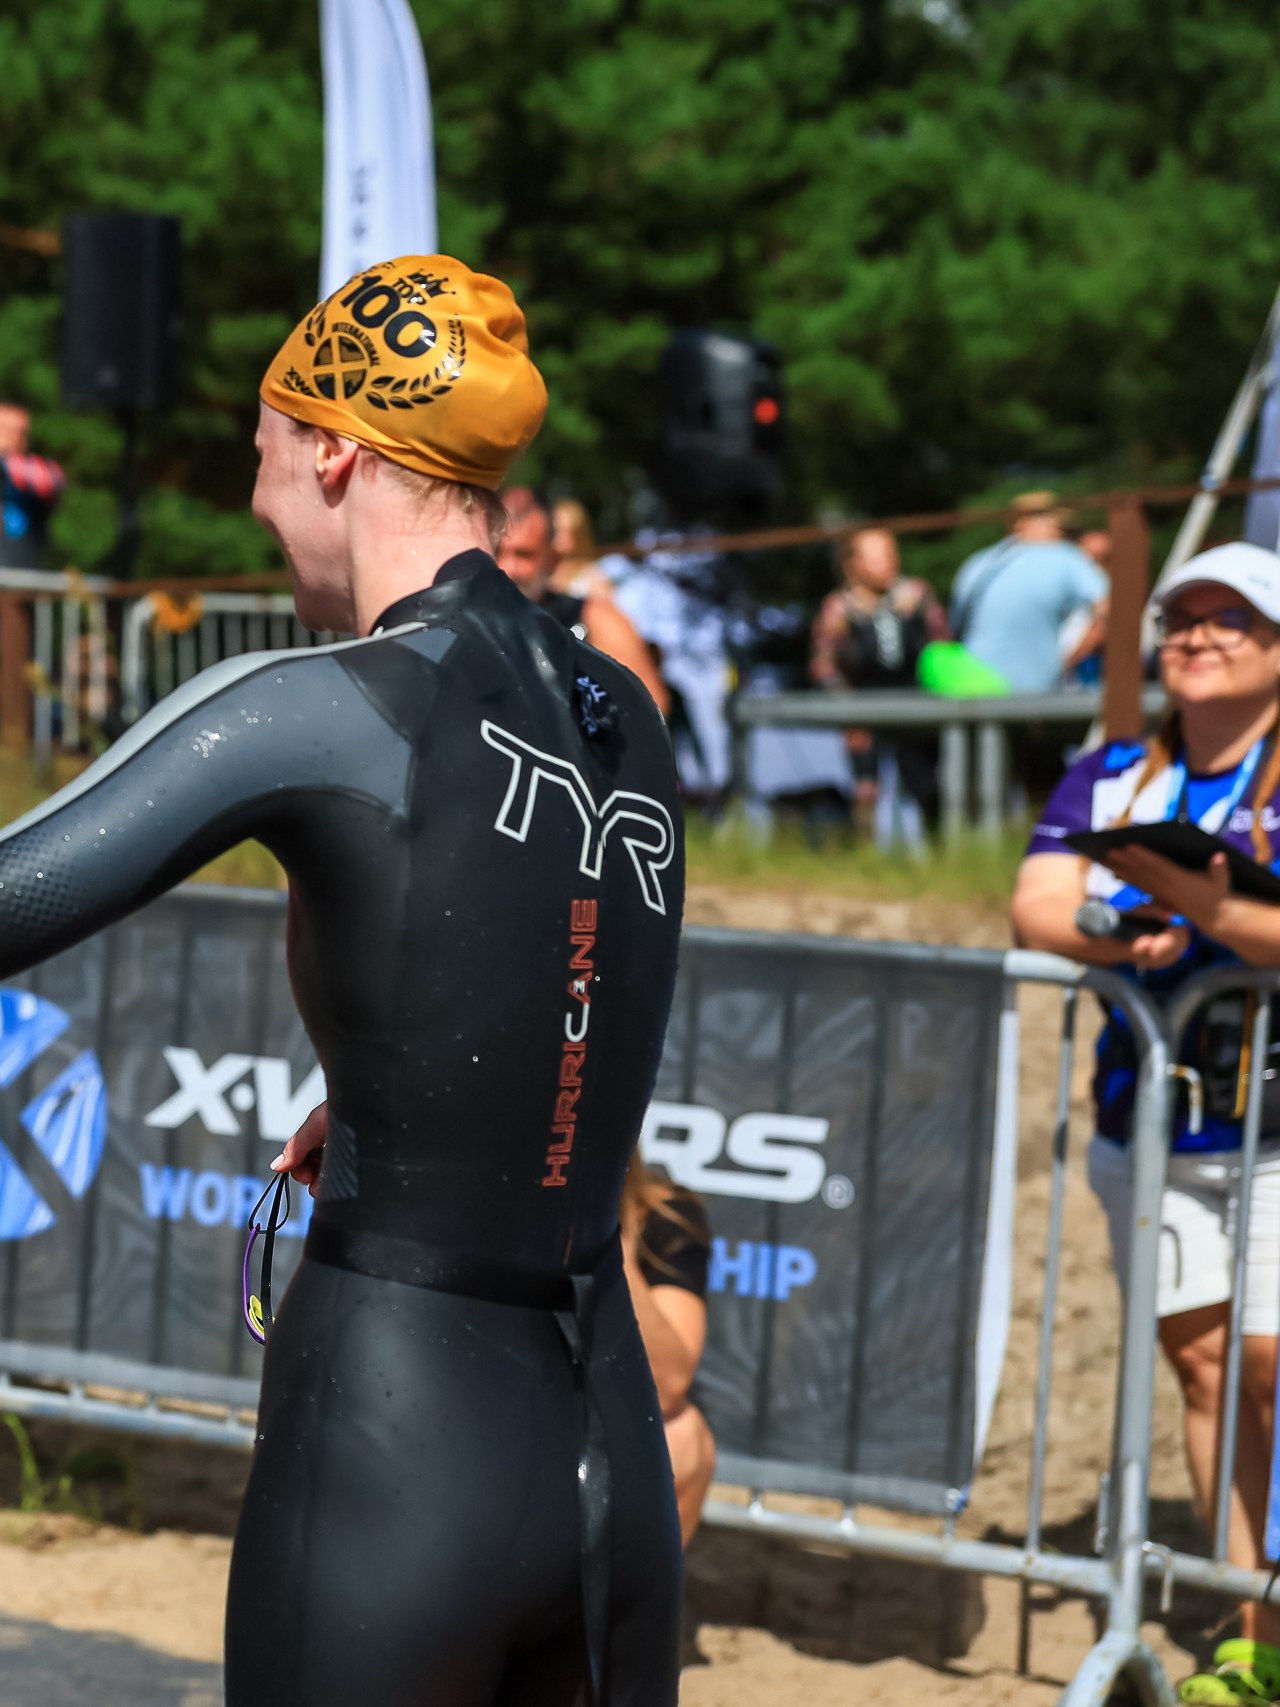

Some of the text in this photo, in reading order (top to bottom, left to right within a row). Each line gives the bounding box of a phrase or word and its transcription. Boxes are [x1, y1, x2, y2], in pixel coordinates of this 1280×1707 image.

[341, 275, 437, 358] 100
[481, 719, 675, 915] TYR
[541, 899, 597, 1187] HURRICANE
